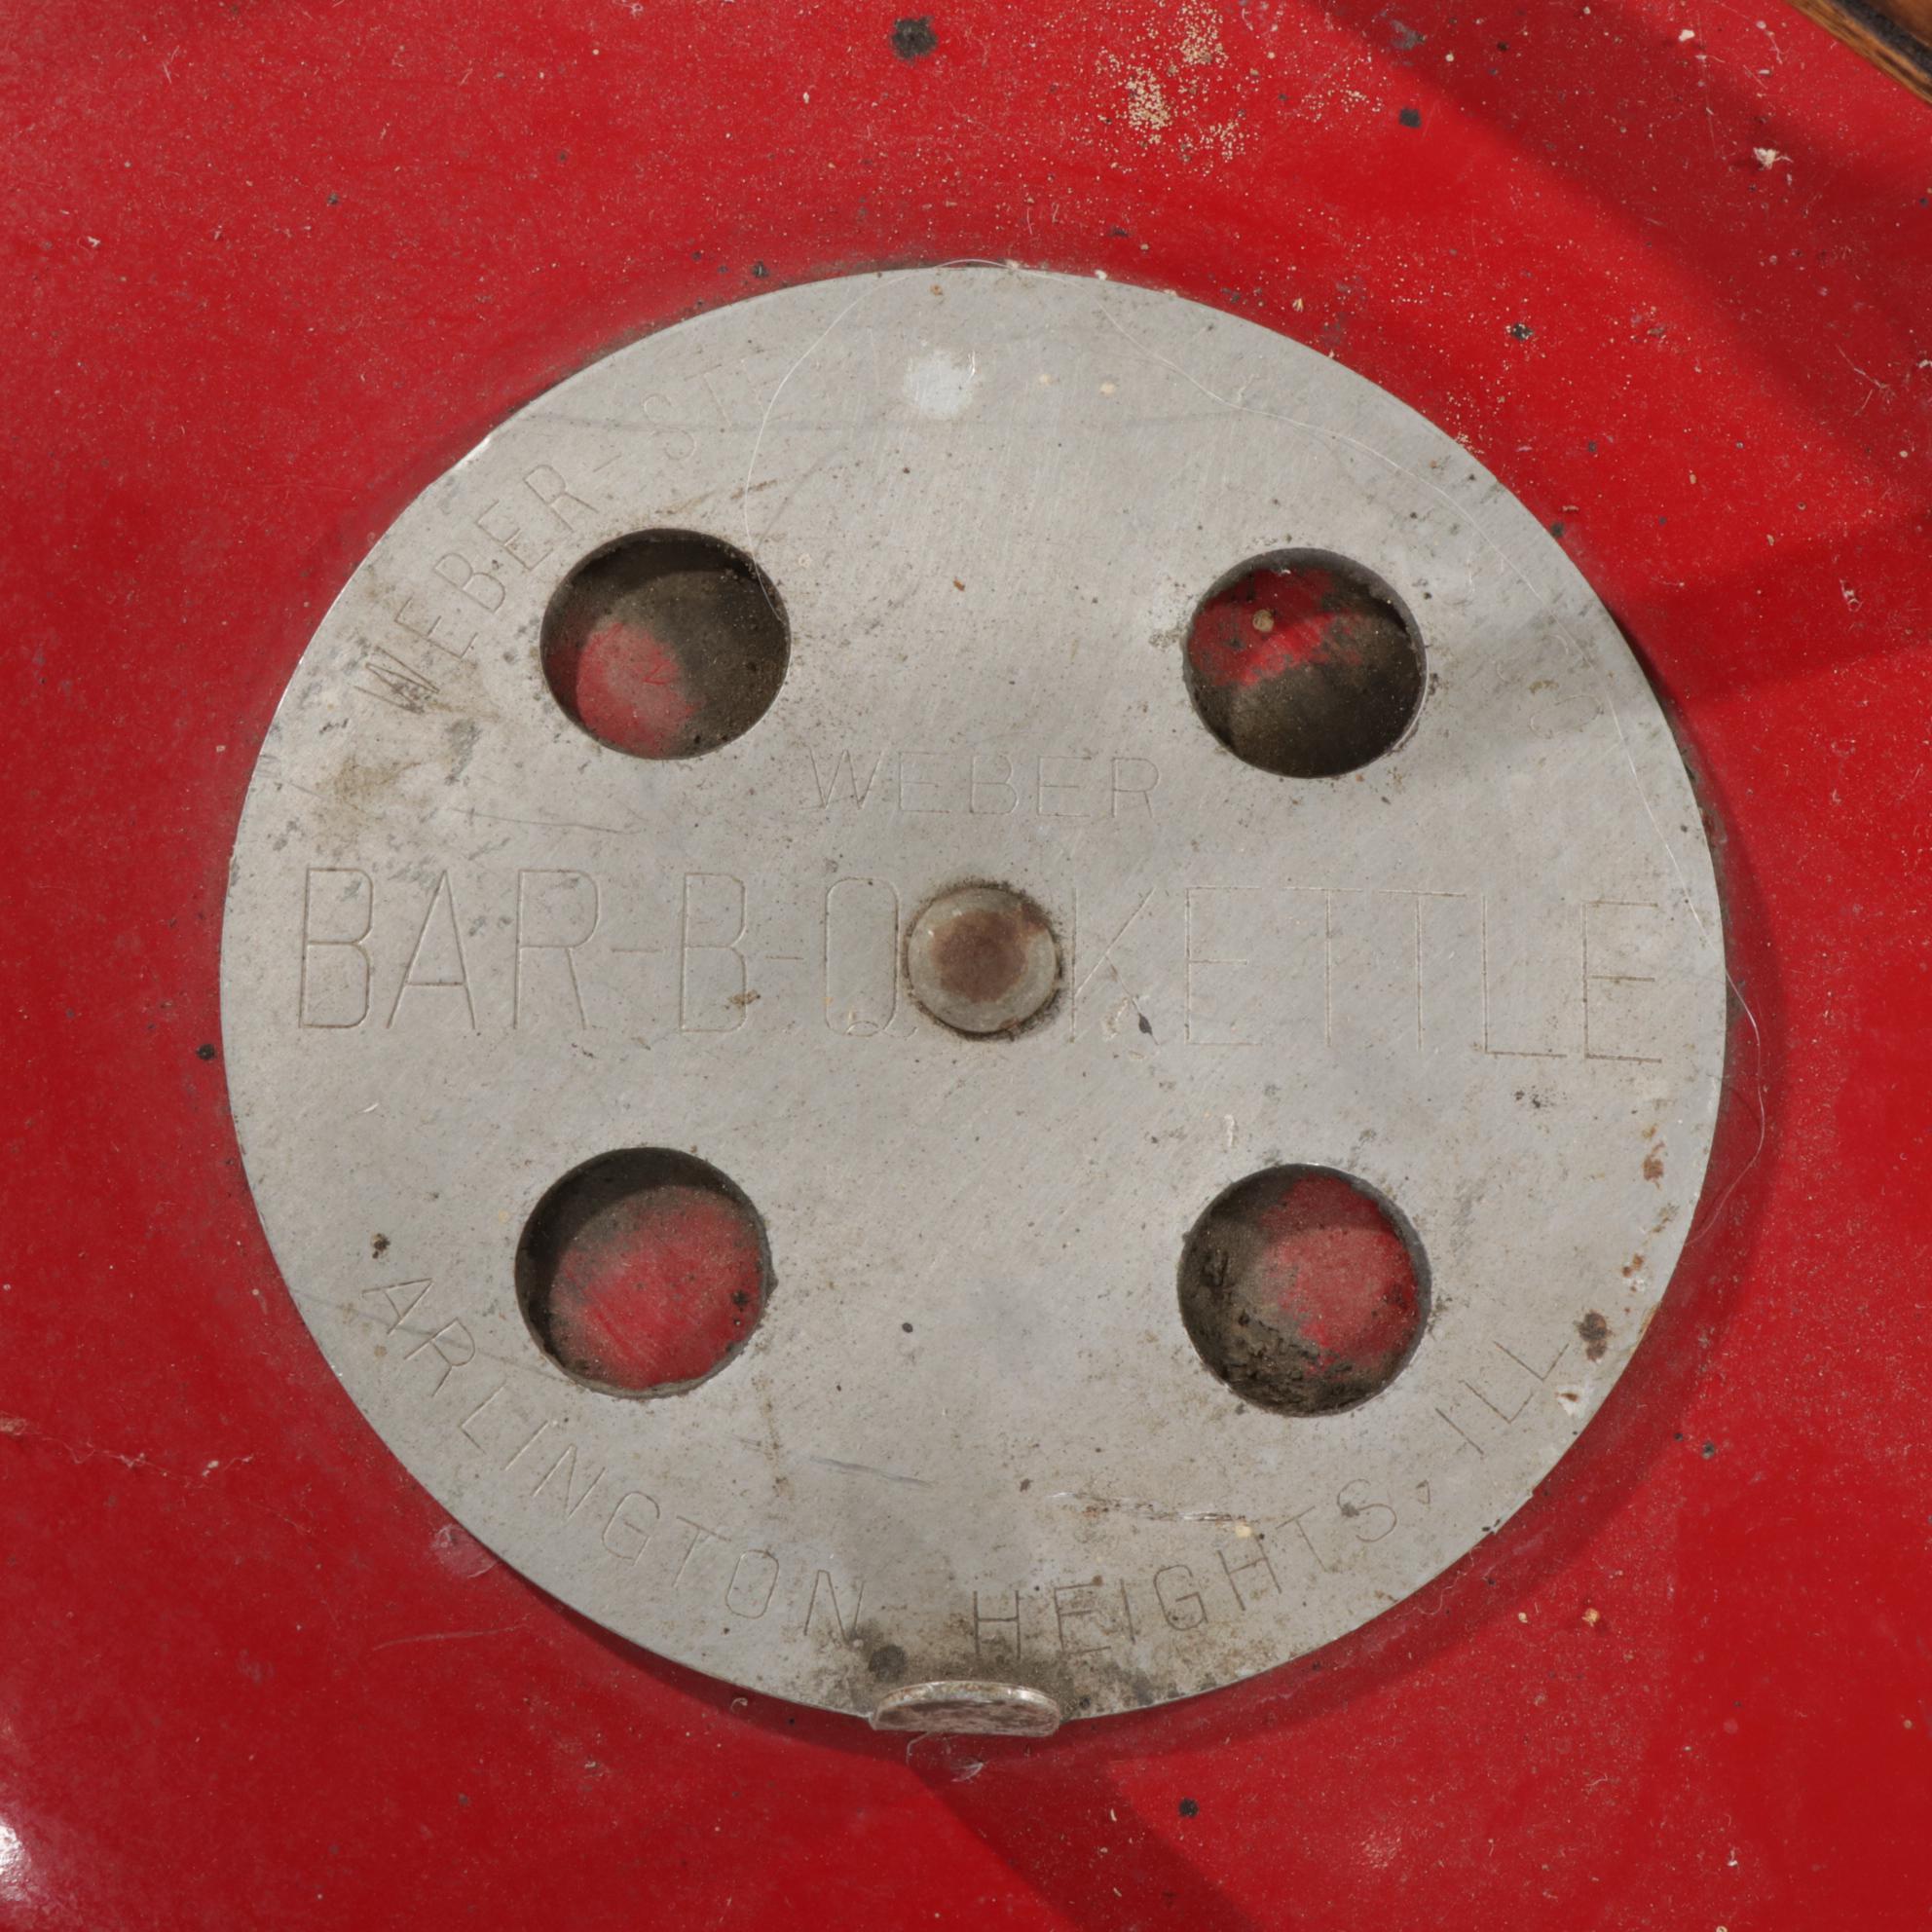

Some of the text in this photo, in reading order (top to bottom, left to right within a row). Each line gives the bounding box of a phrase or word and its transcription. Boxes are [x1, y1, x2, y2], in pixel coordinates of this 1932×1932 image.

[807, 746, 1162, 820] WEBER
[298, 867, 1663, 1063] BAR-B-Q KETTLE
[360, 1276, 870, 1650] ARLINGTON
